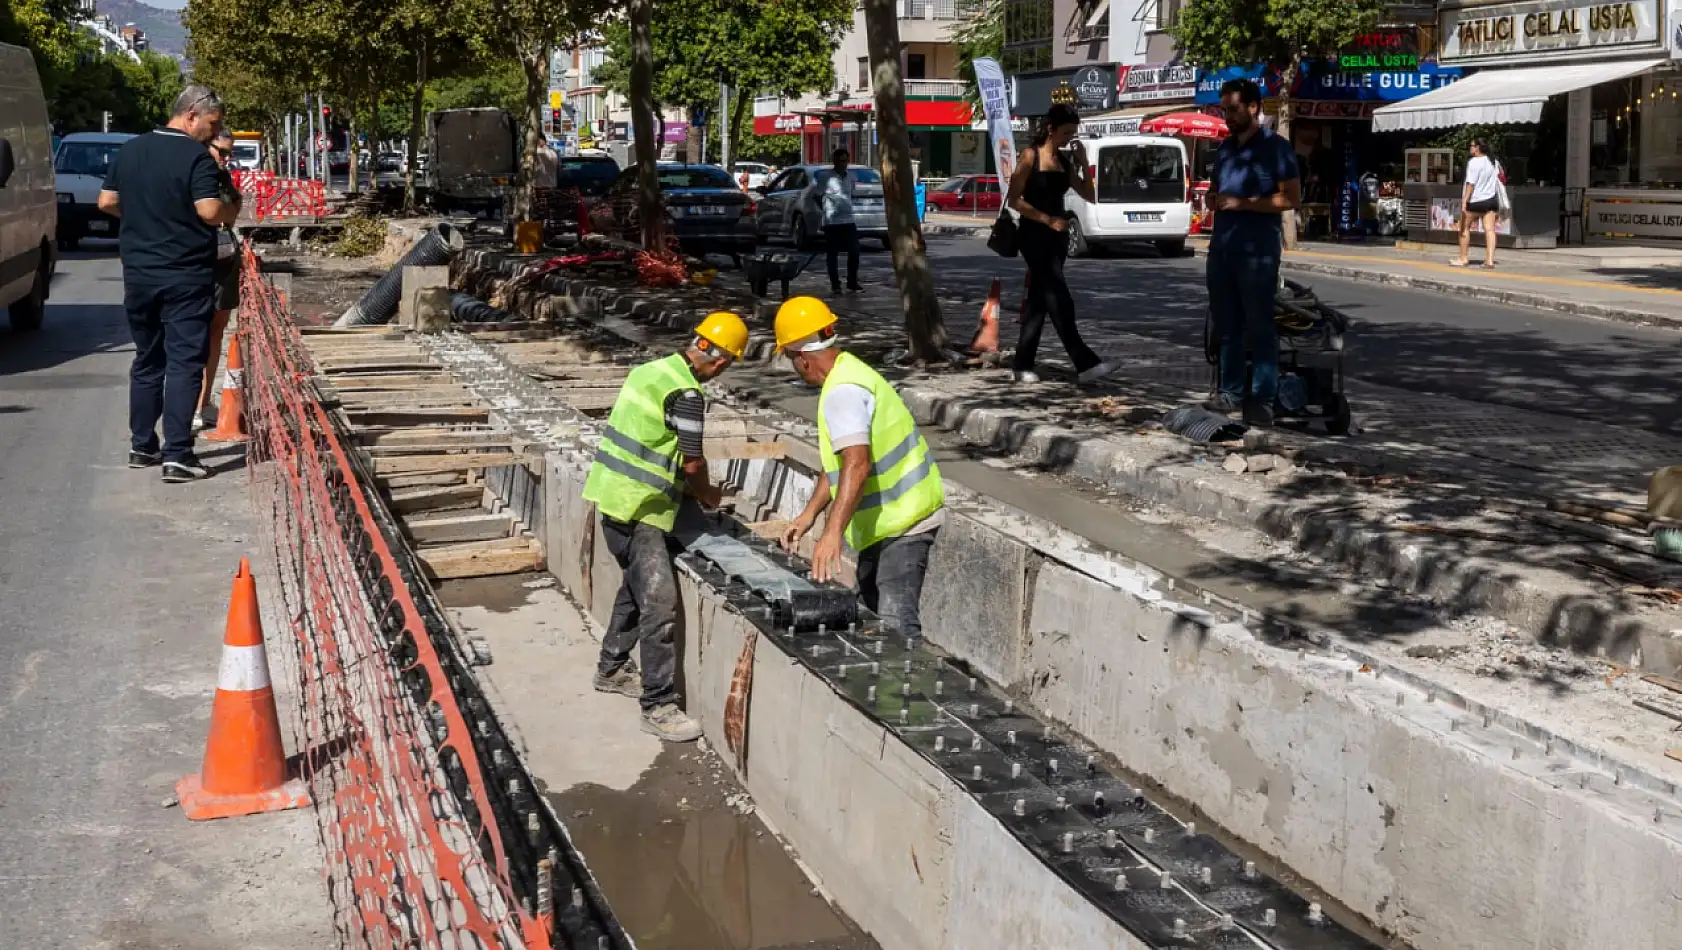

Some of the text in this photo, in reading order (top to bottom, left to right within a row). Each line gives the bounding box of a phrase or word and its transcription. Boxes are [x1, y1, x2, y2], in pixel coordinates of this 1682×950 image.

[1457, 4, 1637, 43] TATLICI CELAL USTA
[1341, 55, 1417, 67] CELAL USTA
[1632, 214, 1662, 225] CELAL
